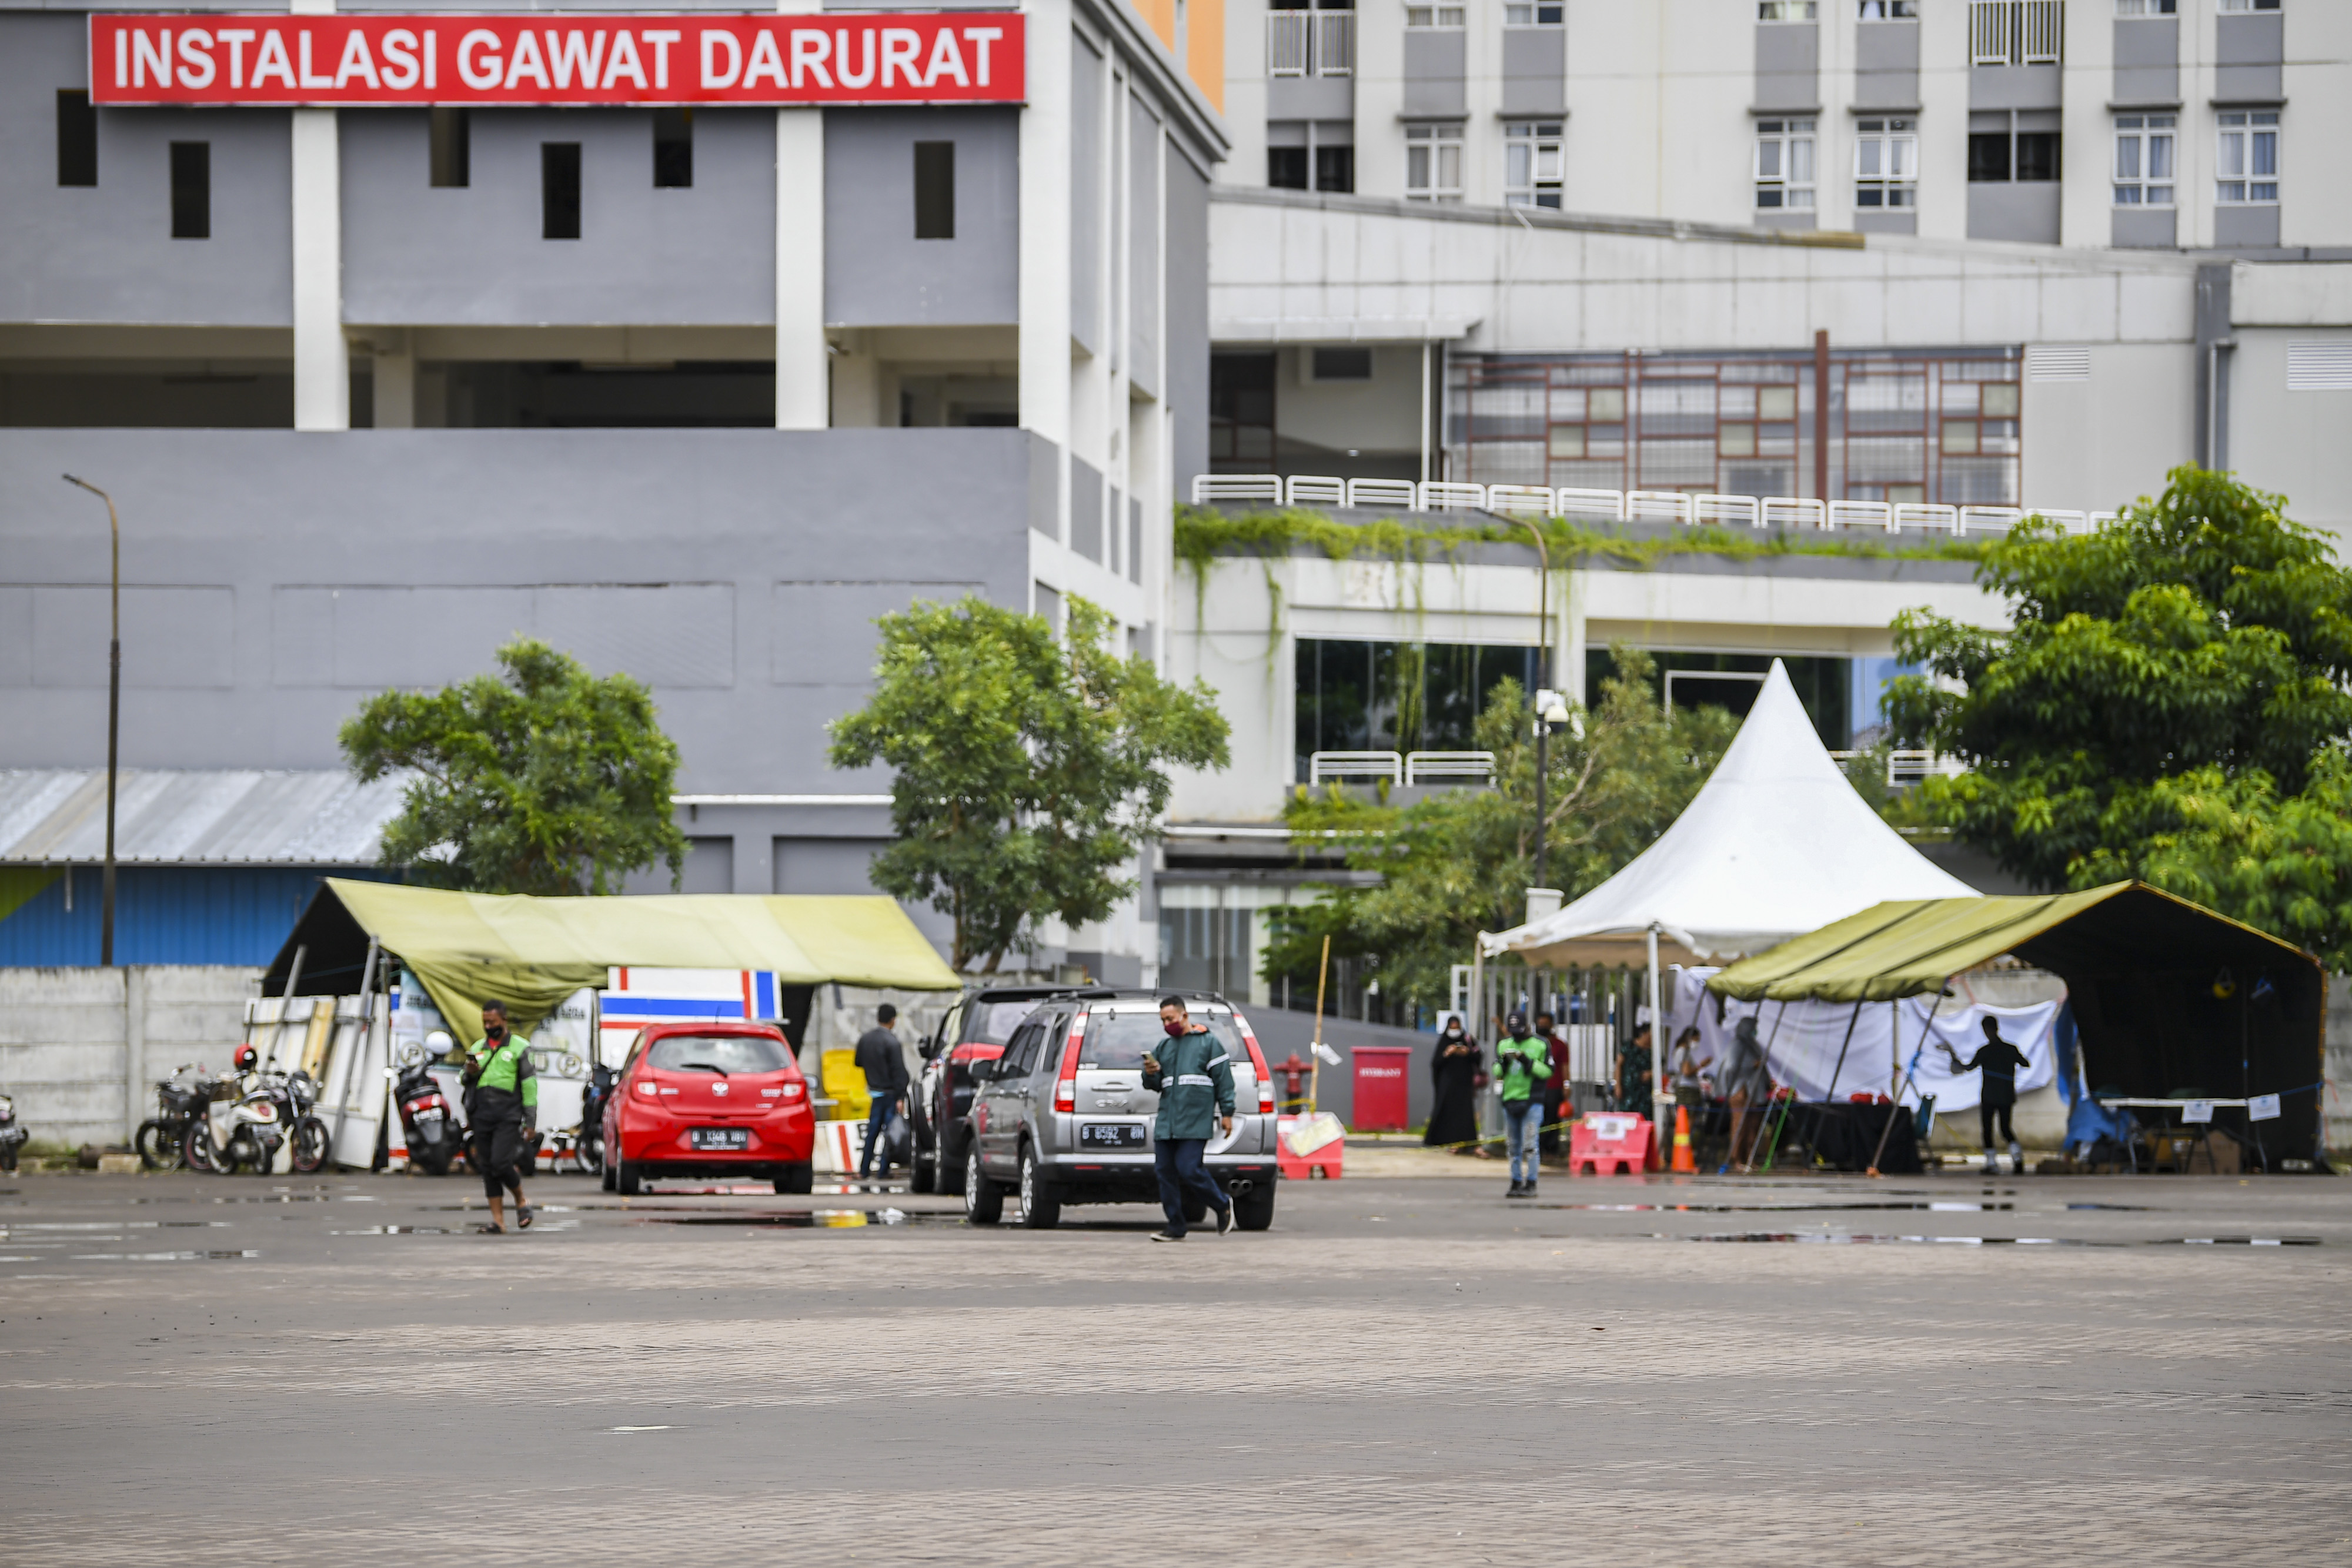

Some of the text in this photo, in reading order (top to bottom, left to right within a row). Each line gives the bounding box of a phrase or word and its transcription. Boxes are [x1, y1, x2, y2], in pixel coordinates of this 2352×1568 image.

[116, 28, 1003, 89] INSTALASI GAWAT DARURAT
[1082, 1126, 1090, 1140] B
